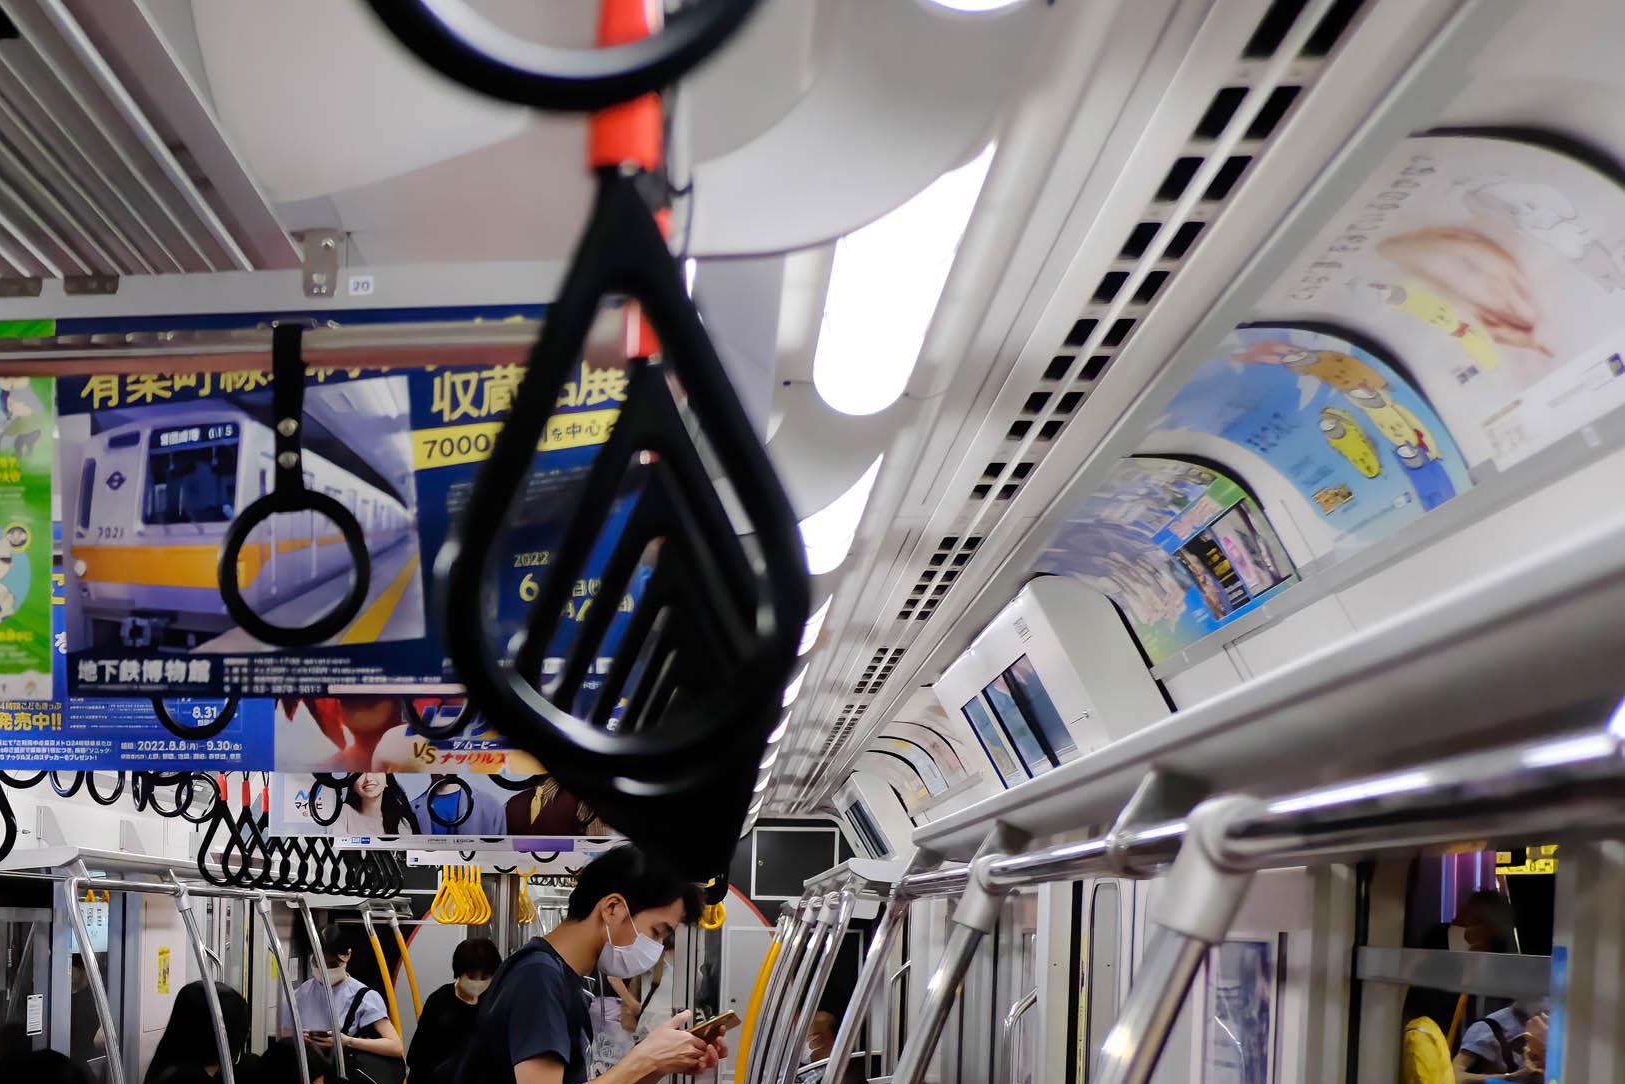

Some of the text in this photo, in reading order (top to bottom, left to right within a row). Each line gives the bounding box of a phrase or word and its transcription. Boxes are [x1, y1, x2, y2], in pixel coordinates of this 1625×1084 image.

[77, 659, 212, 684] 地下鉄博物館
[294, 801, 323, 811] マイビ
